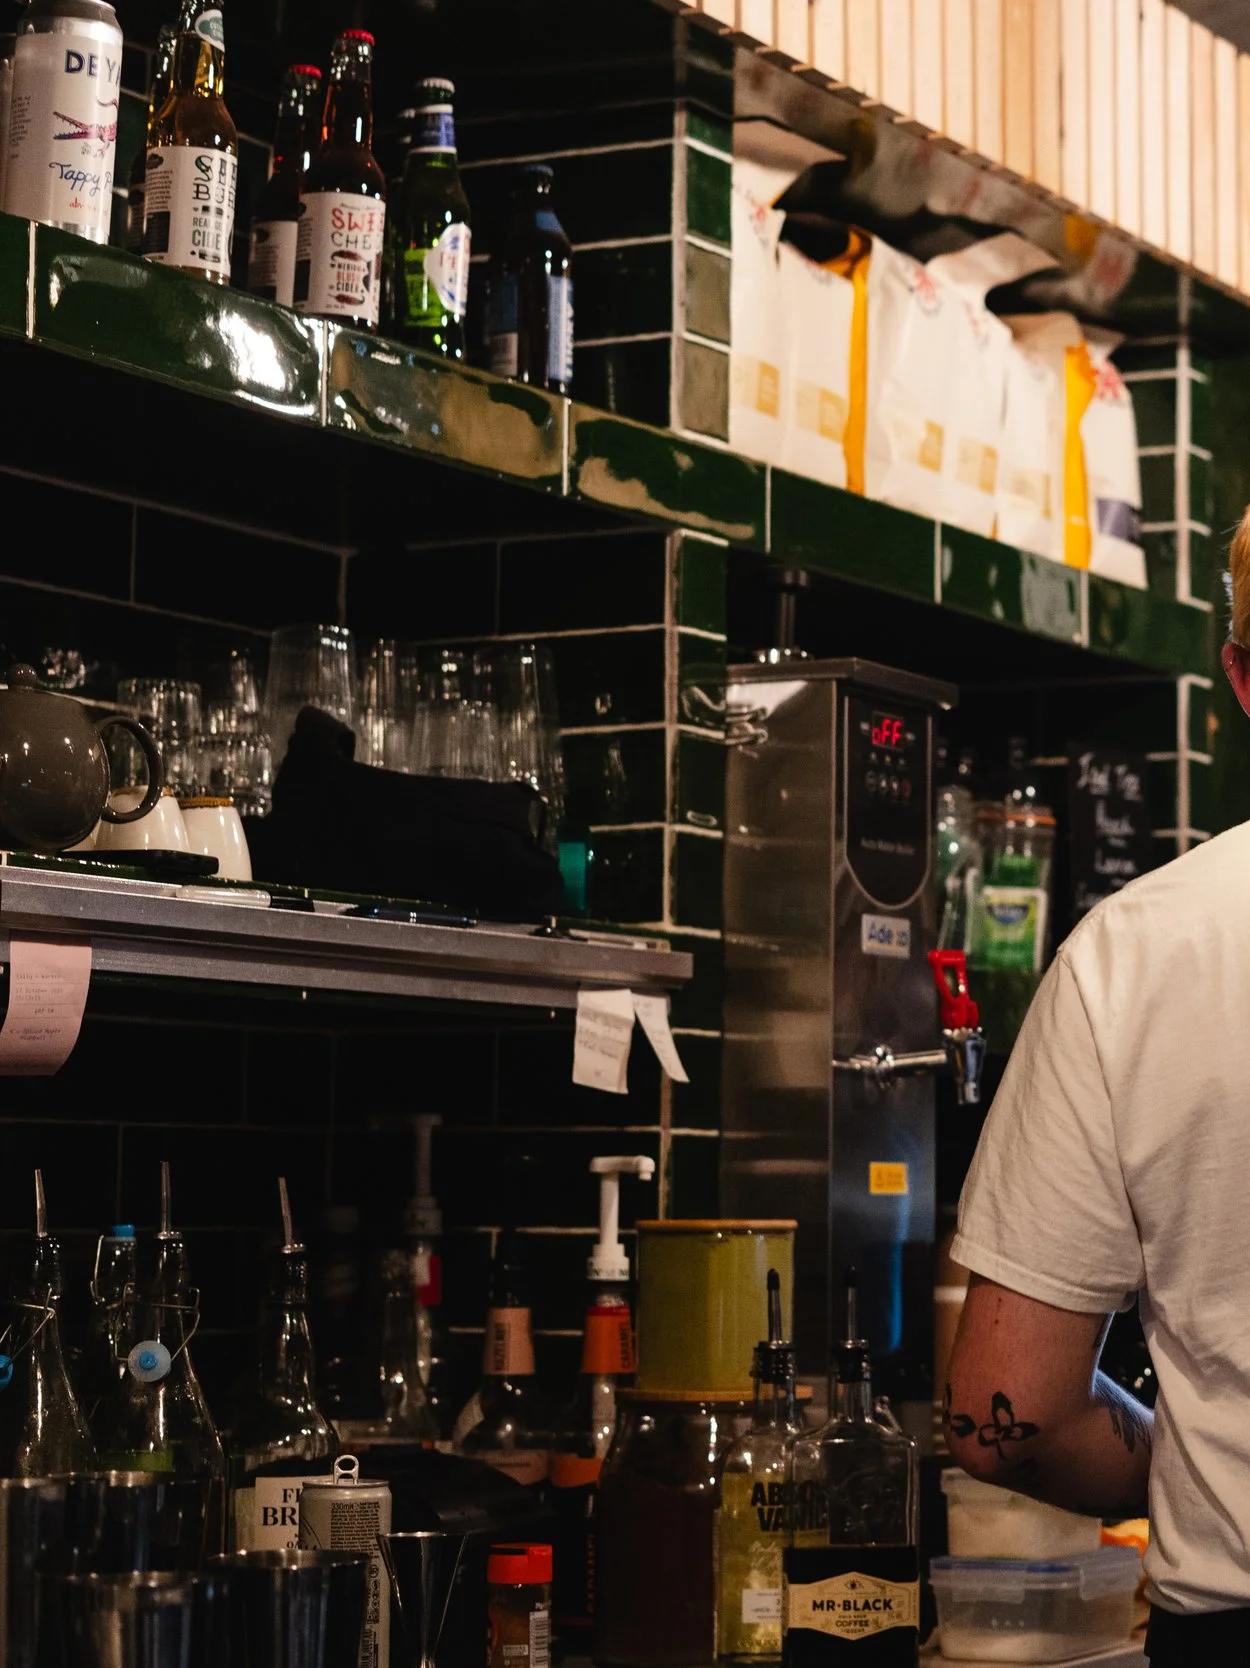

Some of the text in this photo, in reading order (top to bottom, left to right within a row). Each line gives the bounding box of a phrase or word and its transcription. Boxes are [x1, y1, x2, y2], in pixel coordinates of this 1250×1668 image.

[49, 161, 101, 197] Tappy
[191, 229, 226, 251] CIDE
[330, 231, 383, 251] CHE
[835, 1619, 869, 1628] COFFEE
